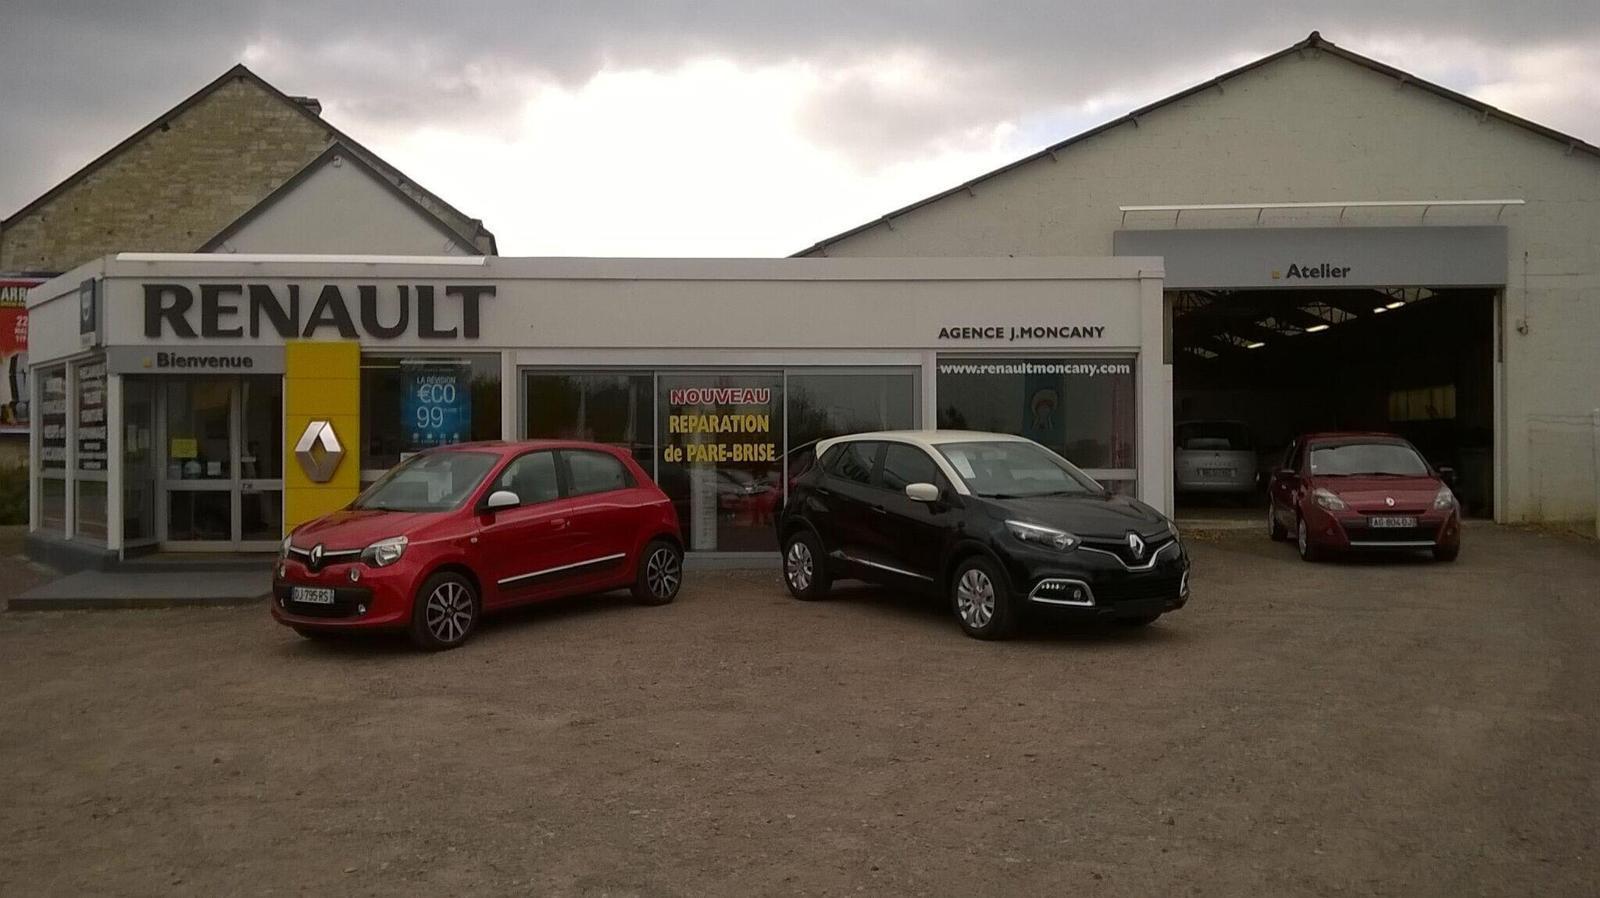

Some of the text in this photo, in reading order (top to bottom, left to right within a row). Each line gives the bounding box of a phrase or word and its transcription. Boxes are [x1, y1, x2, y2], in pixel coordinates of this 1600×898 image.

[1286, 263, 1351, 279] Atelier
[142, 284, 497, 339] RENAULT
[938, 326, 1105, 341] AGENCE J.MONCANY
[157, 353, 253, 369] Bienvenue
[940, 362, 1130, 377] www.renaultmoncany.com
[670, 388, 770, 405] NOUVEAU
[669, 415, 769, 433] REPARATION
[664, 443, 775, 462] de PARE-BRISE
